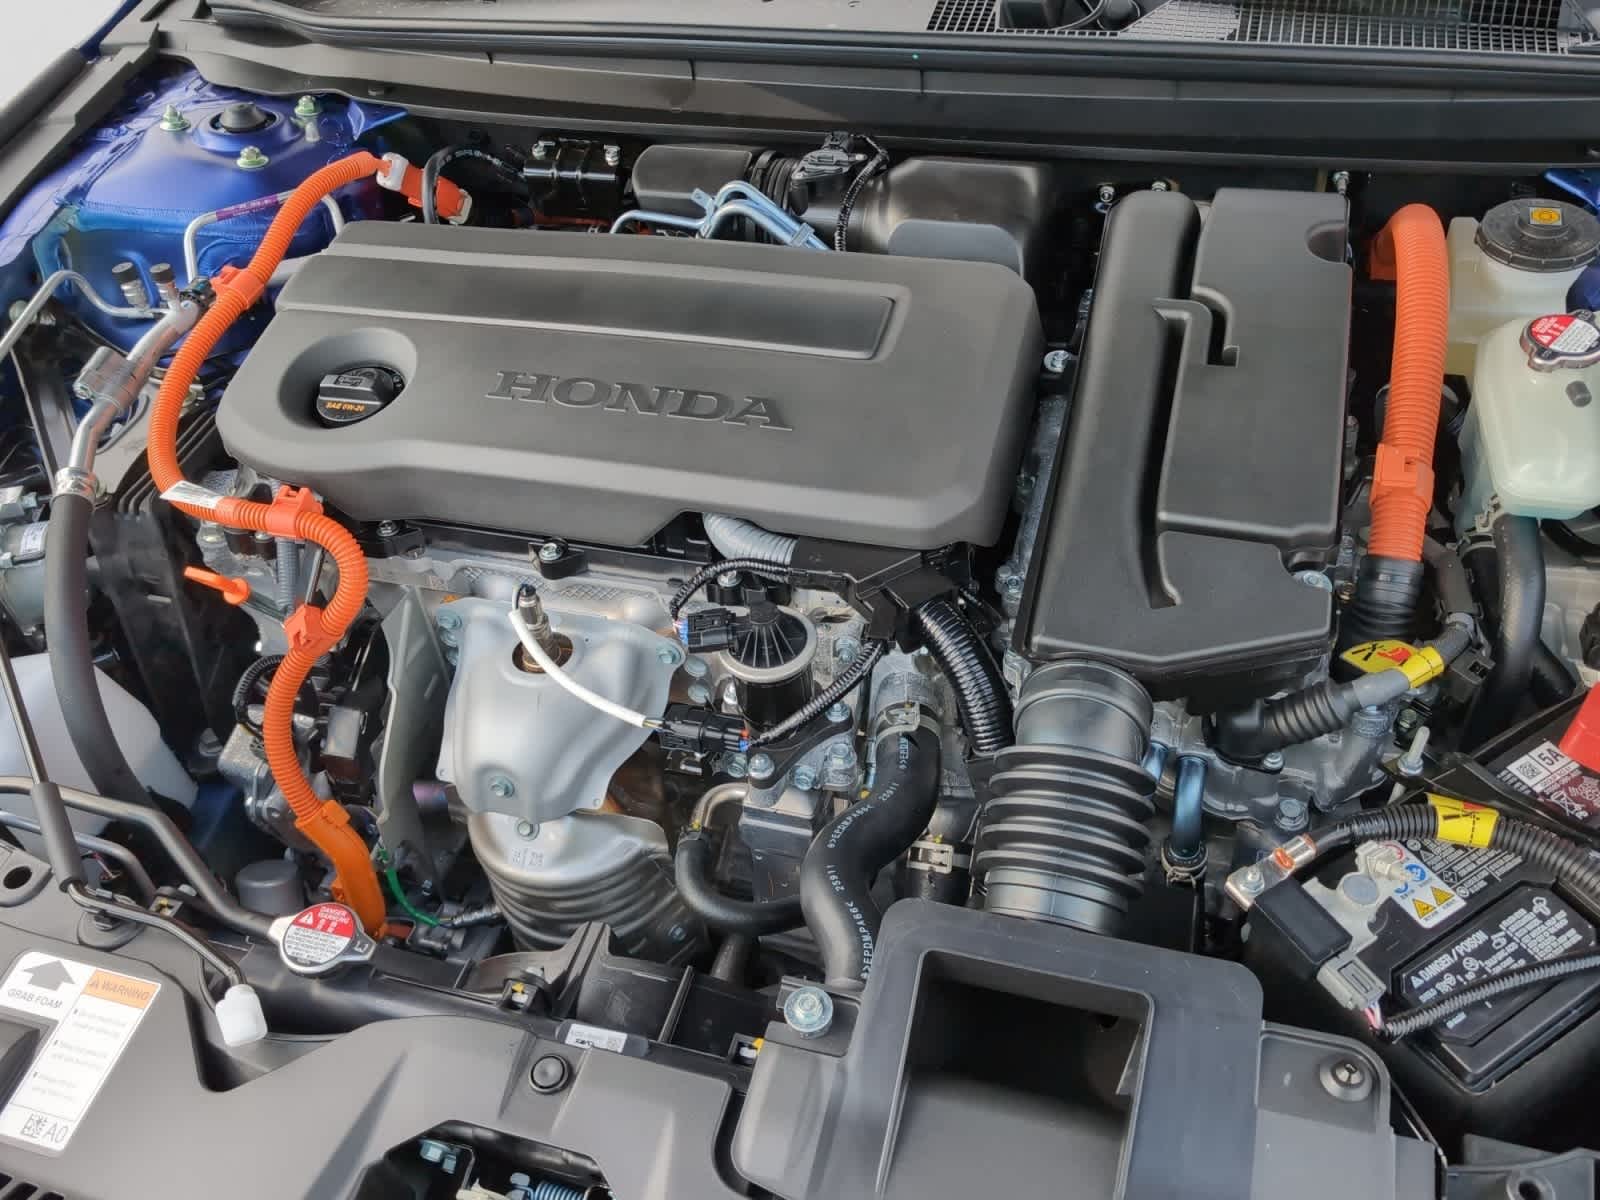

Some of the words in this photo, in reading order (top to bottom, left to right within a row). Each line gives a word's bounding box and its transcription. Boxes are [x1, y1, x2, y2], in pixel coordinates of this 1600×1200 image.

[484, 370, 793, 431] HONDA
[1537, 748, 1565, 766] 5A
[7, 988, 34, 1002] GRAB
[34, 995, 63, 1009] FOAM
[101, 979, 150, 1001] WARNING
